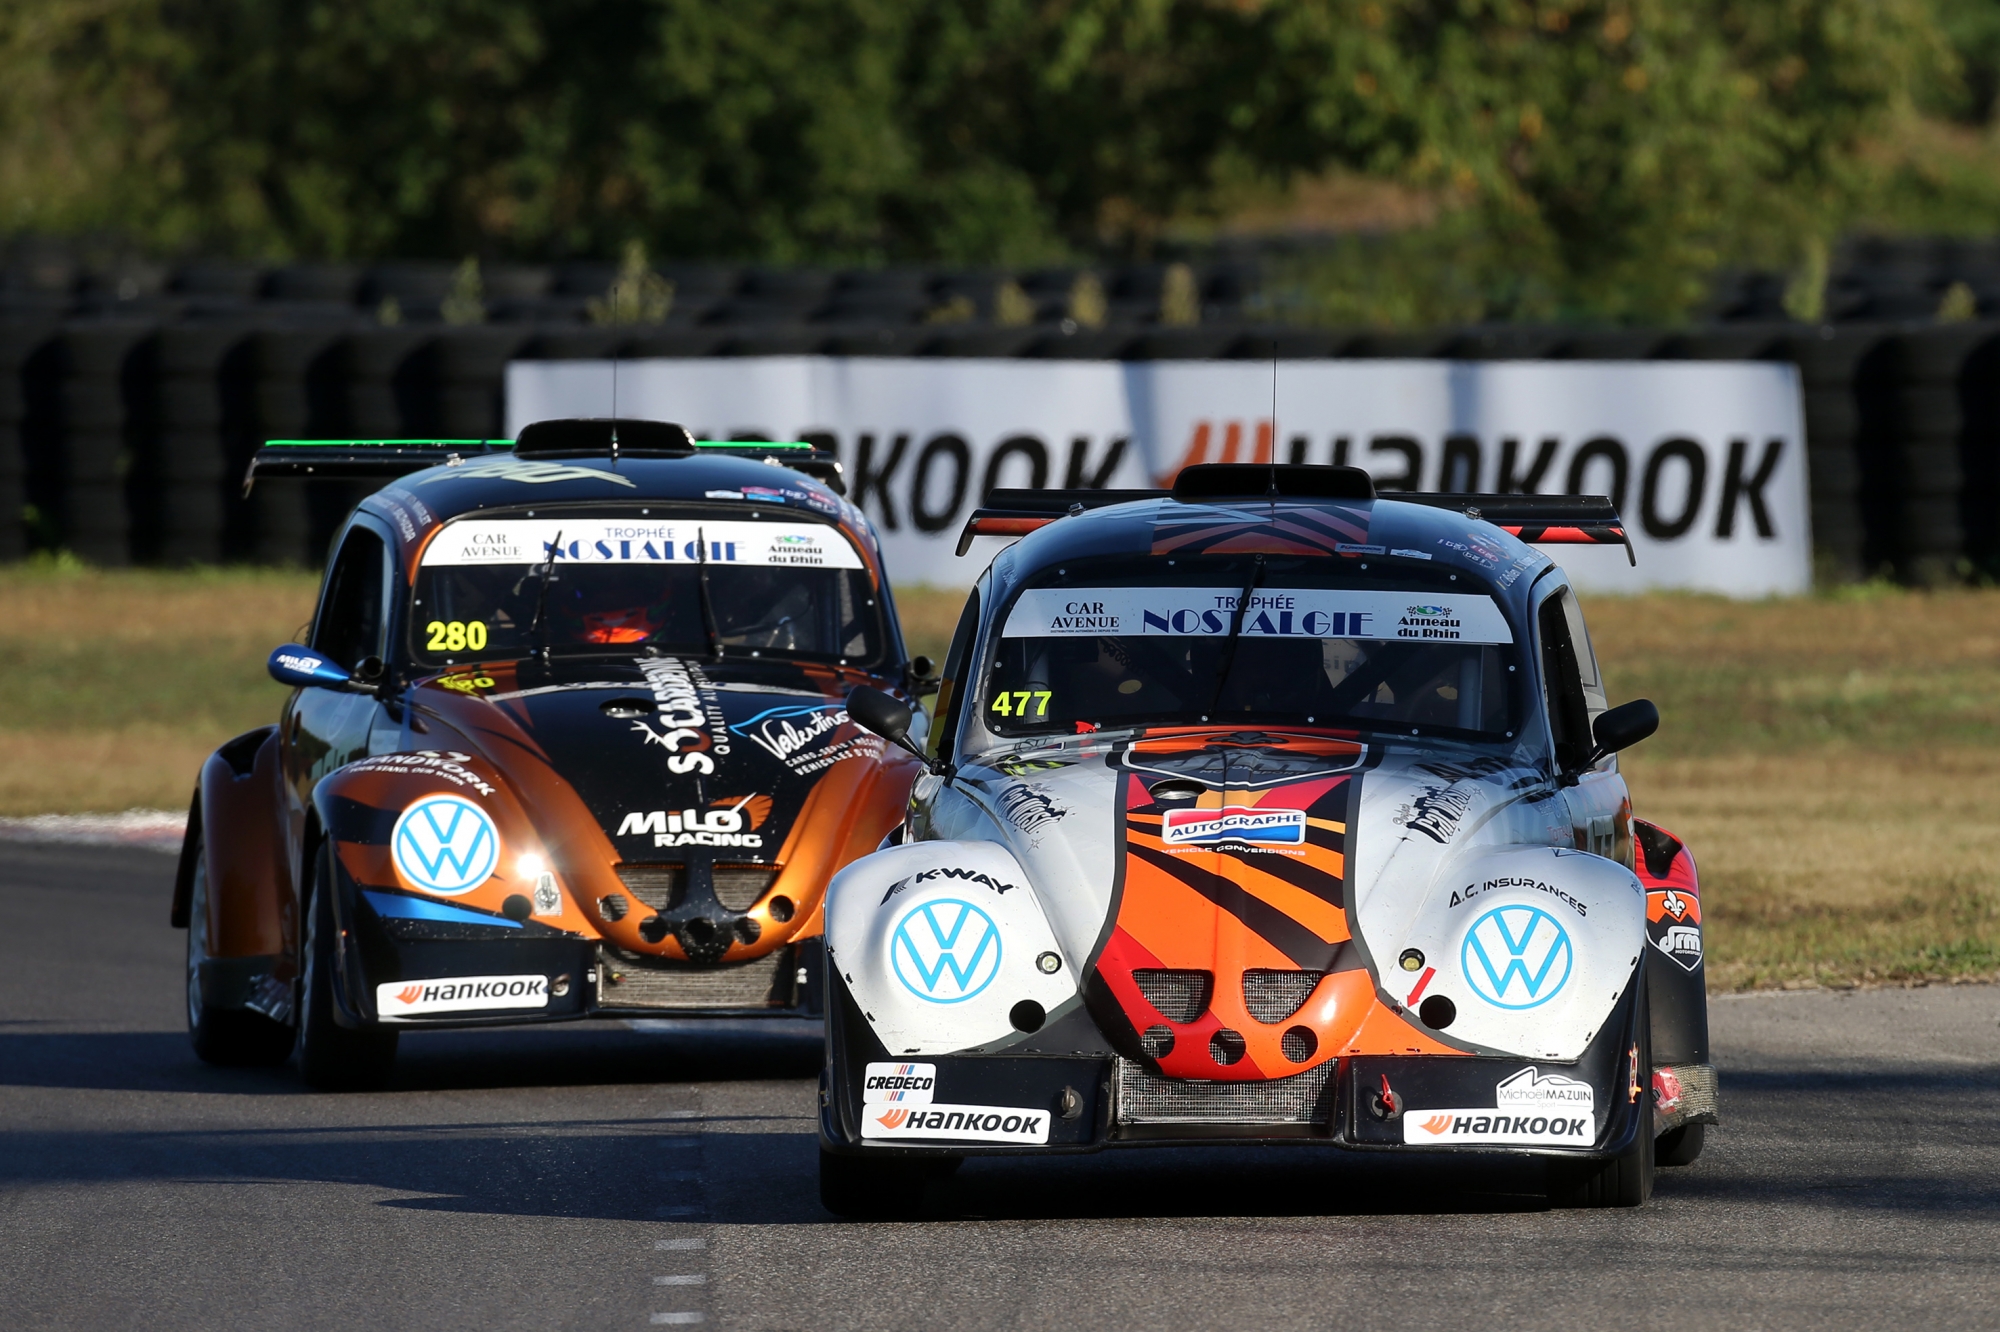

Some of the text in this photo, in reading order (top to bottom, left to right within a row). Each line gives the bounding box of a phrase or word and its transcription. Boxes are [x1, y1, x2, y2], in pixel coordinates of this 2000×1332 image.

[473, 533, 507, 544] CAR
[605, 526, 675, 538] TROPHÉE
[461, 546, 522, 557] AVENUE
[543, 539, 746, 562] NOSTALGIE
[768, 545, 823, 555] Anneau
[768, 555, 787, 564] du
[790, 555, 823, 564] Rhin
[1065, 601, 1105, 615] CAR
[1050, 616, 1120, 628] AVENUE
[1142, 608, 1374, 636] NOSTALGIE
[1397, 616, 1461, 628] Anneau
[426, 621, 488, 651] 280
[1397, 627, 1460, 639] du Rhin
[992, 690, 1052, 717] 477
[706, 704, 731, 755] QUALITY
[750, 710, 849, 761] Valentino
[411, 766, 435, 775] OUR
[435, 769, 467, 787] WORK
[1170, 814, 1302, 838] AUTOGRAPHE
[654, 832, 763, 847] RACING
[1161, 845, 1306, 856] VEHICLE CONVERSIONS
[916, 868, 1014, 895] K-WAY
[1449, 878, 1588, 917] A.C. INSURANCES
[866, 1076, 933, 1091] CREDECO
